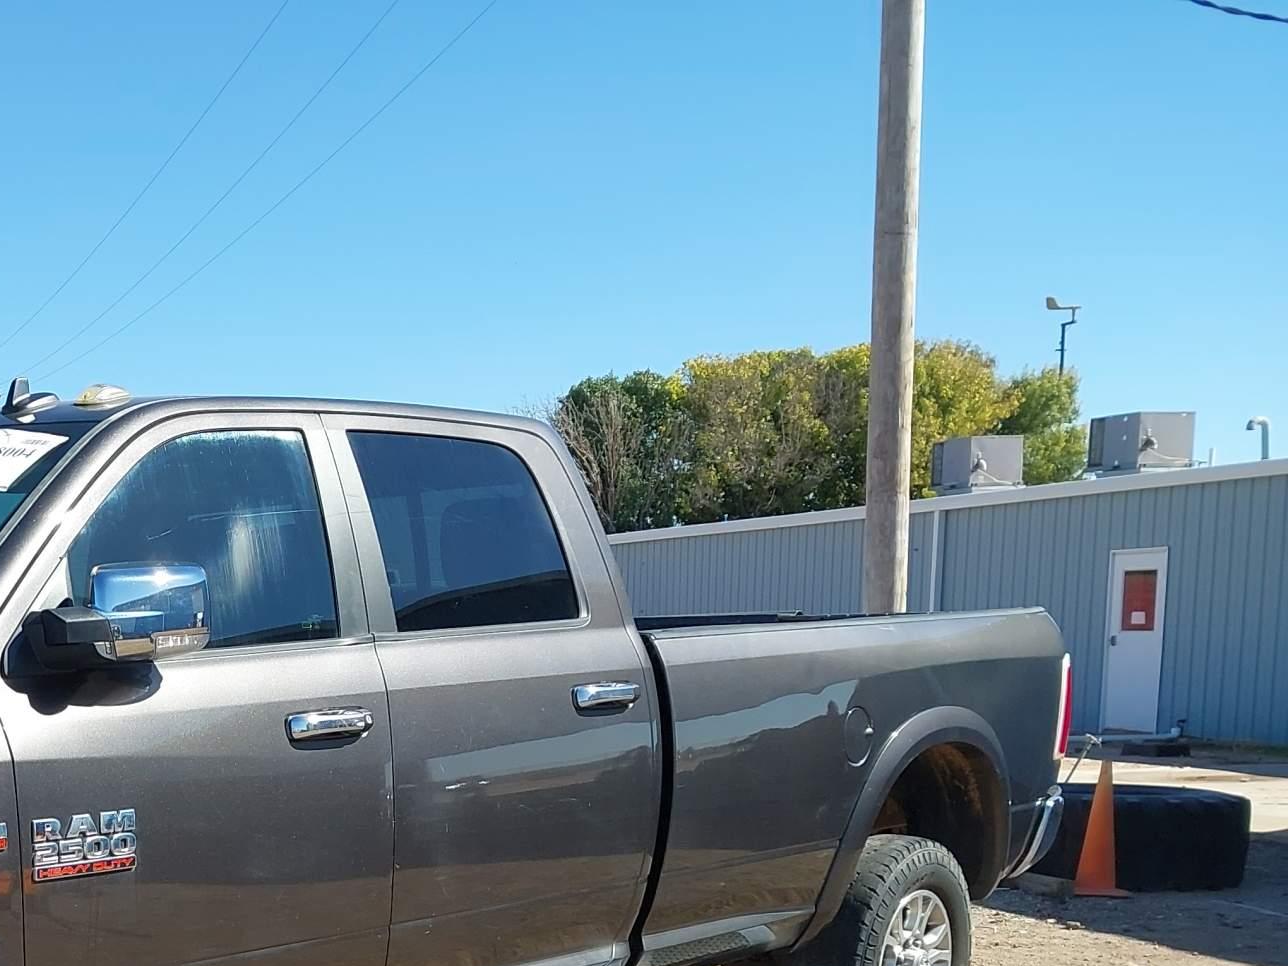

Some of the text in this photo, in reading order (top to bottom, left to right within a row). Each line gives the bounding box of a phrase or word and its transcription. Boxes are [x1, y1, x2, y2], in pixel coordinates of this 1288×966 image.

[31, 808, 136, 842] RAM
[32, 832, 137, 866] 2500
[38, 857, 134, 879] HEAVY DUTY
